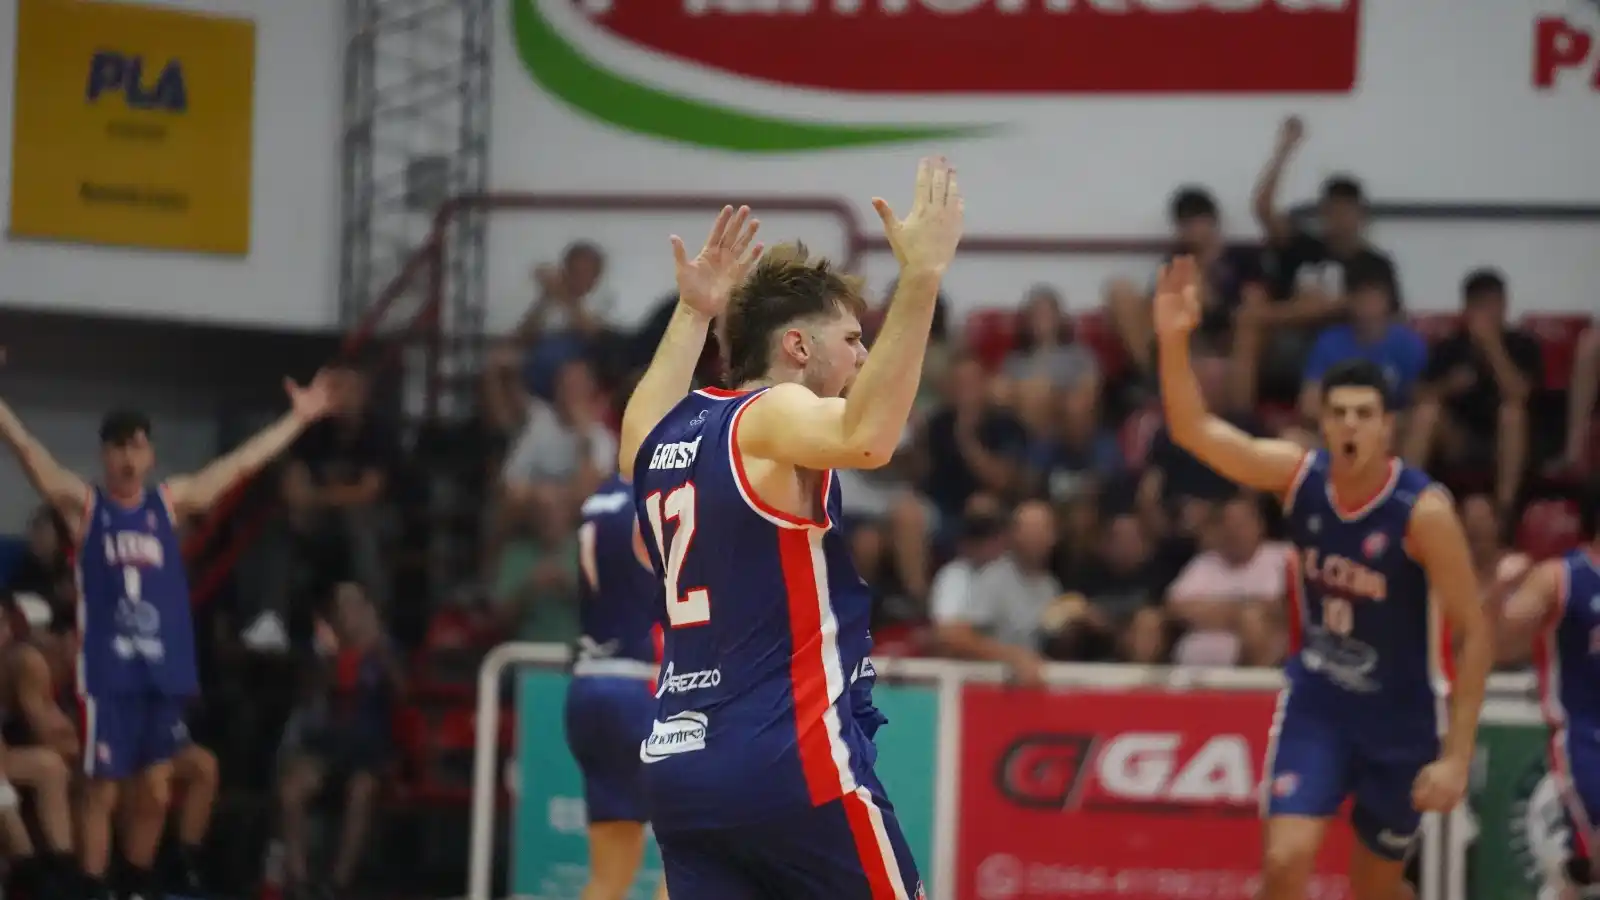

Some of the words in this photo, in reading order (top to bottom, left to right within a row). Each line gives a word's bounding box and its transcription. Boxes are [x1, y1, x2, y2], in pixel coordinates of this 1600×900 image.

[86, 50, 189, 114] PLA
[1533, 15, 1600, 92] P
[645, 481, 711, 629] 12
[1098, 732, 1258, 802] GA
